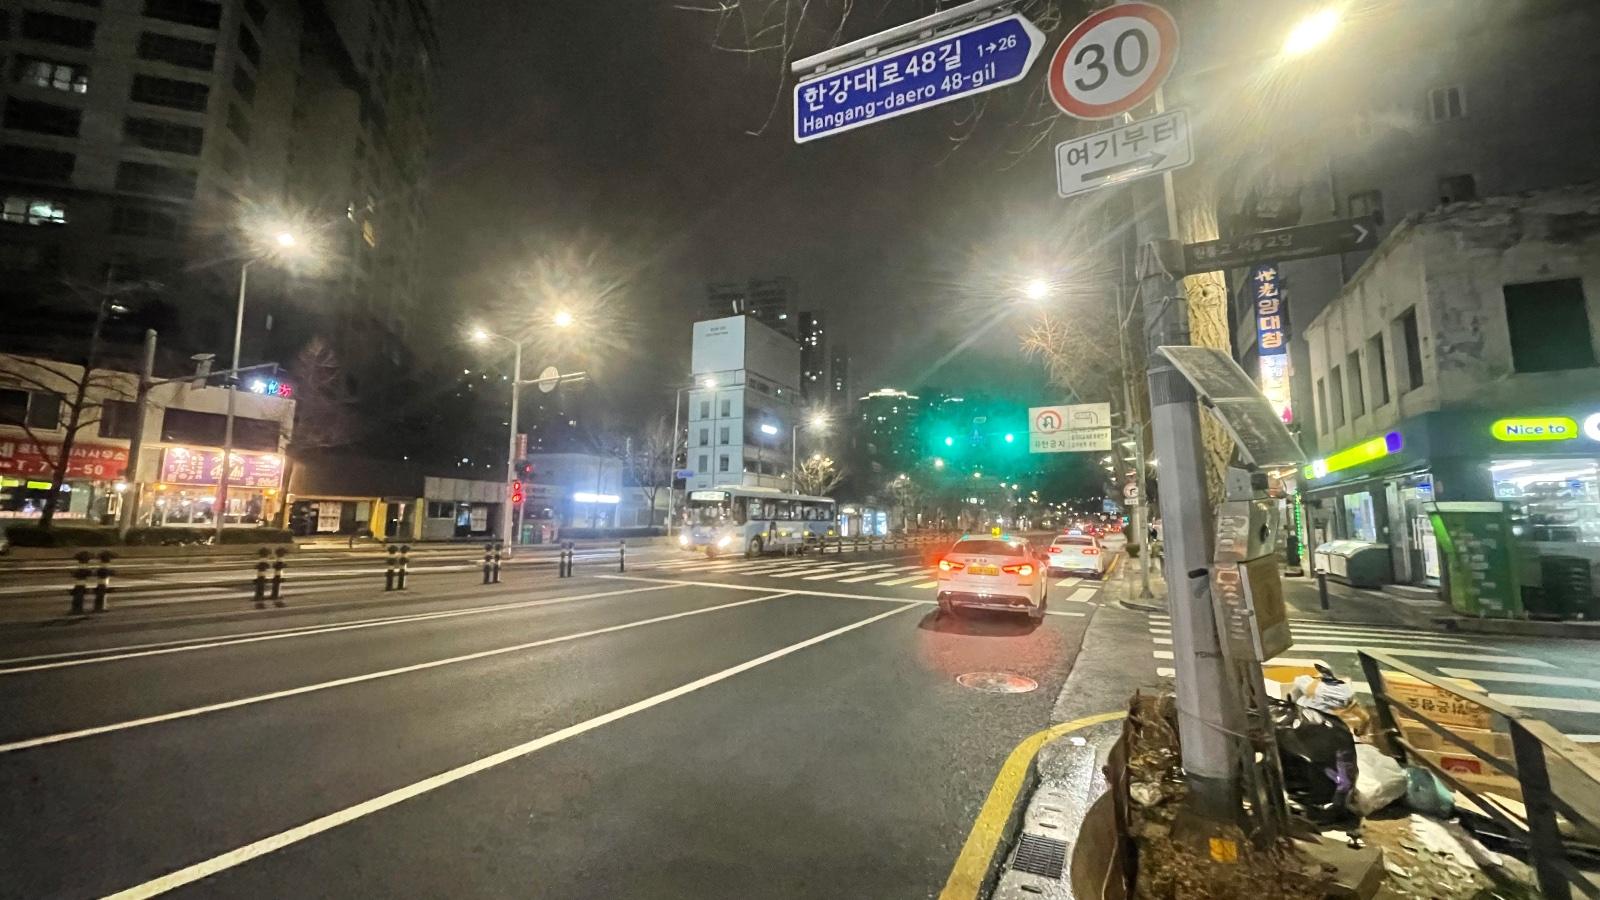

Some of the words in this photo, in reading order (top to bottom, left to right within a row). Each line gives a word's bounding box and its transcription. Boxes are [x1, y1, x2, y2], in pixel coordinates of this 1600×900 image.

[804, 40, 962, 112] 한강대로48길
[1073, 28, 1150, 92] 30
[803, 84, 936, 133] Hangang-daero
[940, 63, 996, 93] 48-gil
[1066, 117, 1180, 167] 여기부터
[1506, 424, 1544, 435] Nice
[1549, 424, 1566, 434] to
